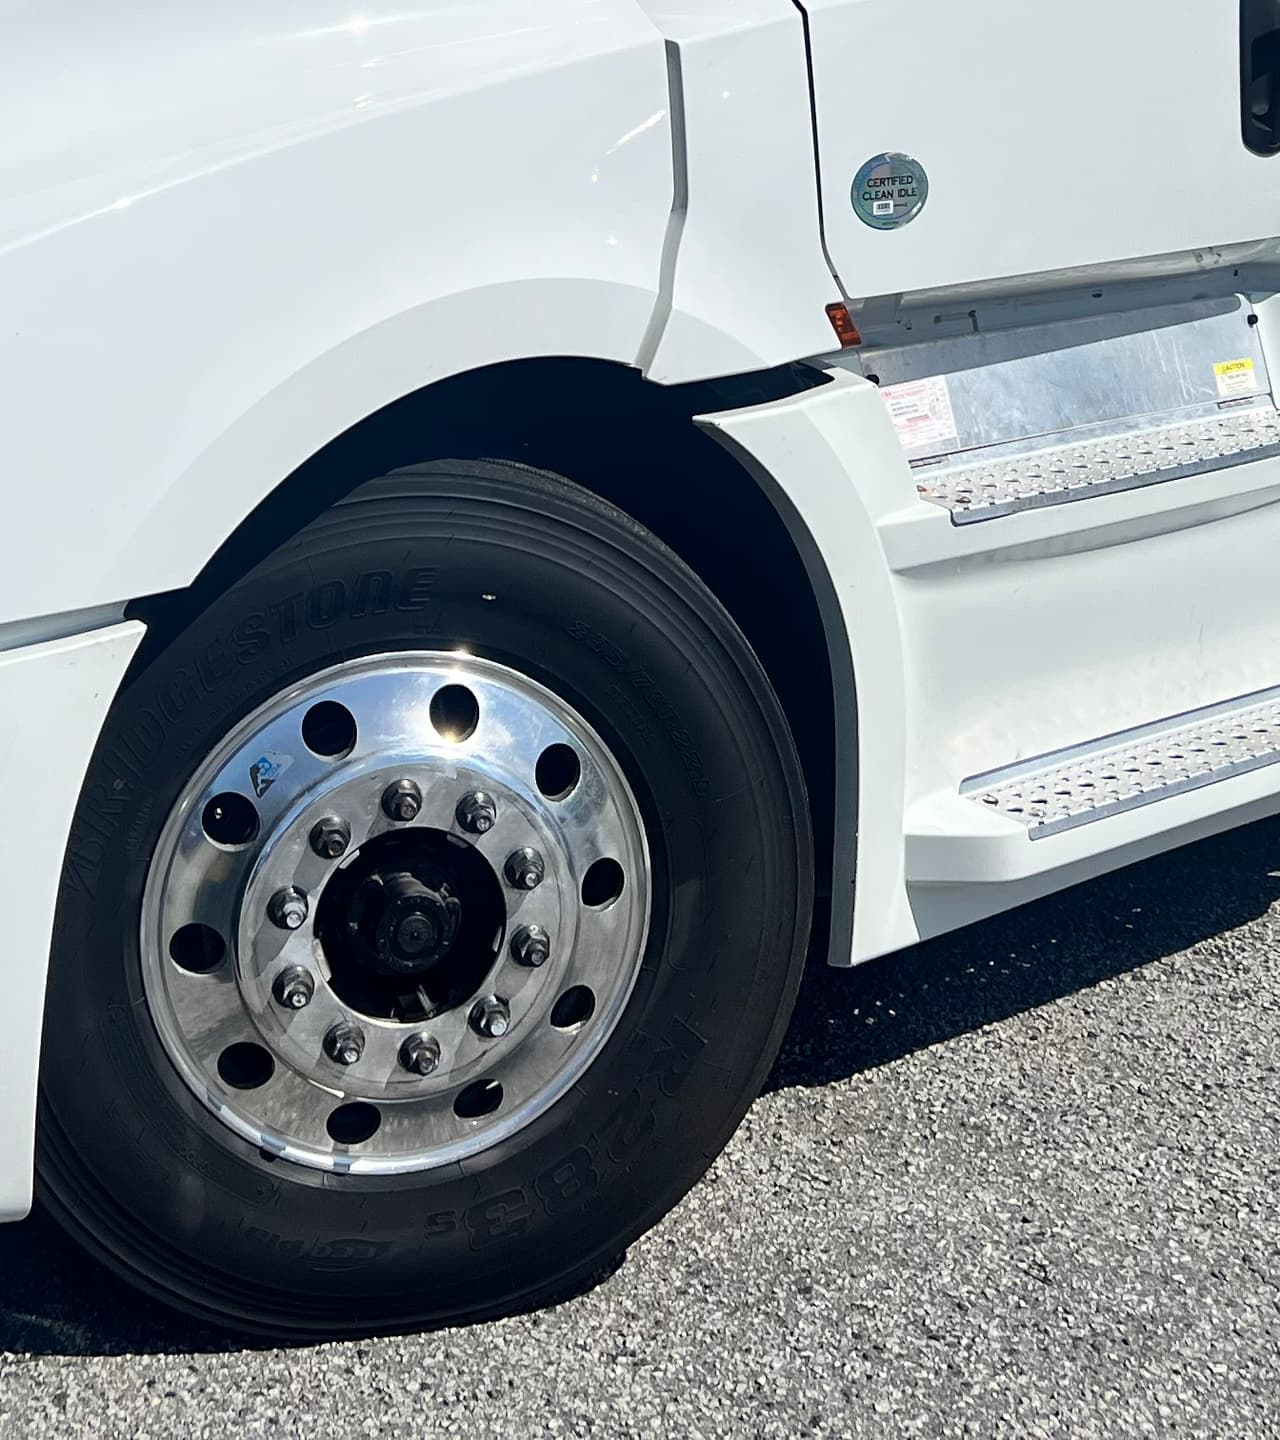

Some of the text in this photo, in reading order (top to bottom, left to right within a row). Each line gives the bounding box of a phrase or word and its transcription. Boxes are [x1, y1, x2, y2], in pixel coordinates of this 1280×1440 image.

[867, 175, 913, 188] CERTIFIED
[862, 187, 918, 201] CLEAN IDLE
[59, 564, 442, 902] BRIDGESTONE
